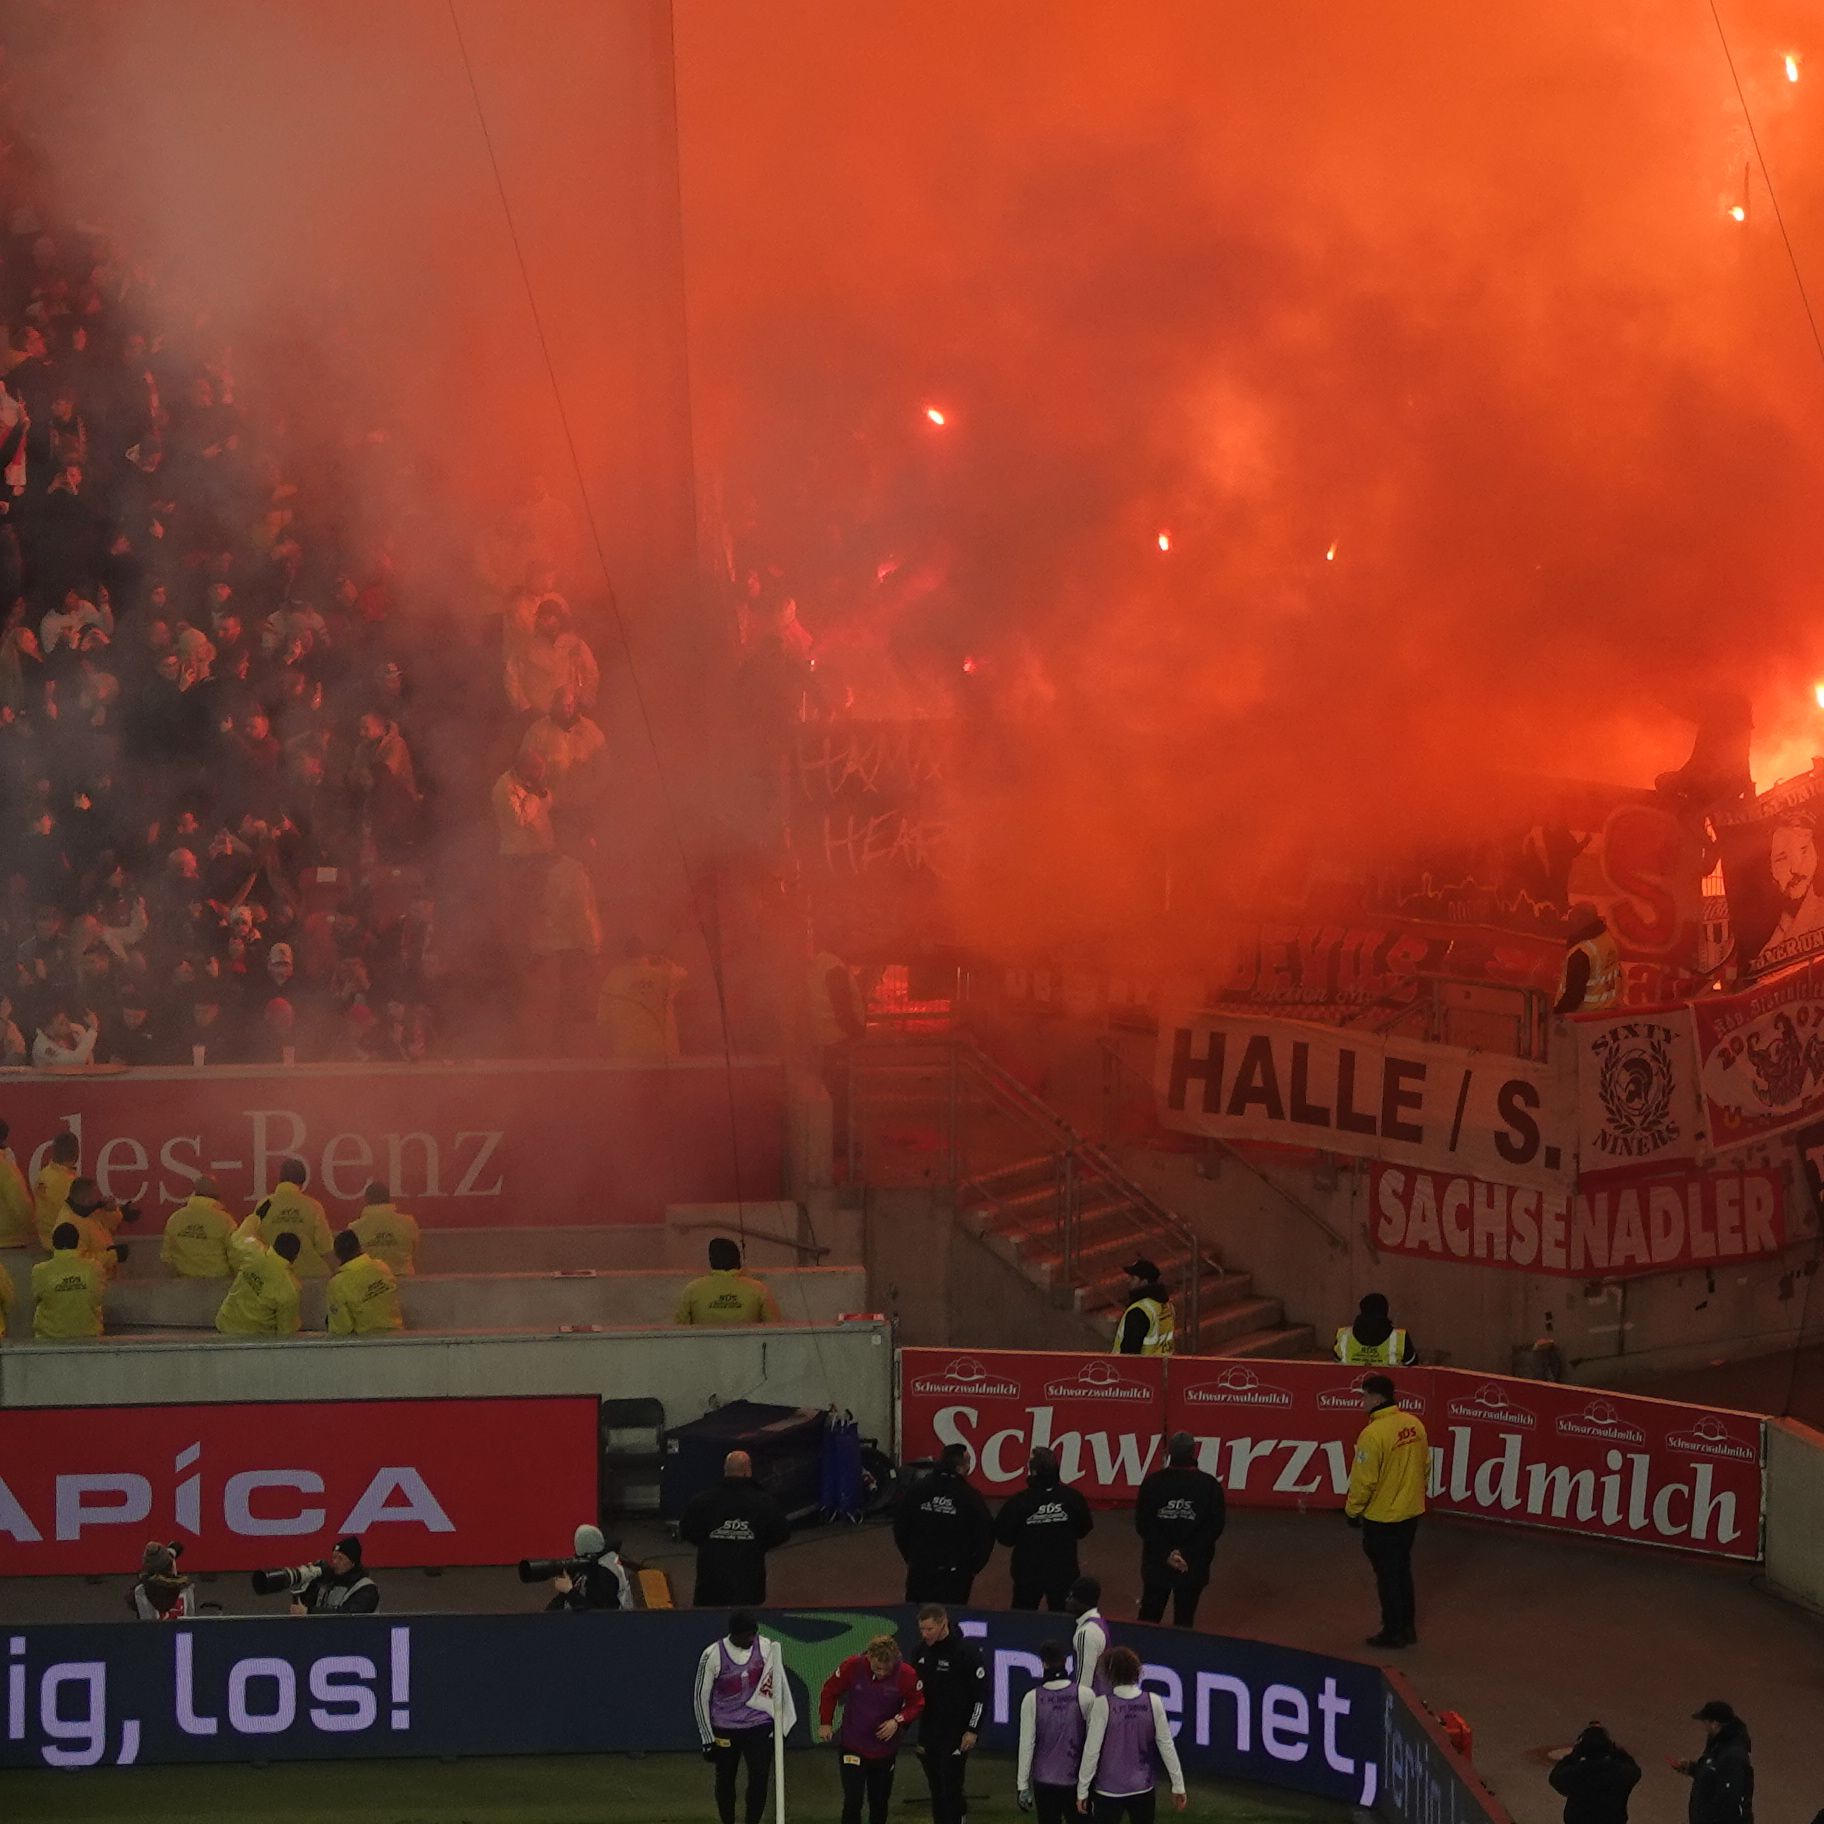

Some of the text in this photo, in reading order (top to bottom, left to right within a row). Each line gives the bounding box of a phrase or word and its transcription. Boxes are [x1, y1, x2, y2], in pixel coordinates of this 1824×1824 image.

[1592, 1023, 1681, 1057] SIXTY
[1167, 1028, 1562, 1170] HALLE / S.
[1376, 1167, 1780, 1271] SACHSENADLER
[914, 1380, 1018, 1397] Schwarzwaldmilch
[1047, 1385, 1152, 1401] Schwarzwaldmilch
[1186, 1390, 1290, 1406] Schwarzwaldmilch
[1449, 1402, 1535, 1427] Schwarzwaldmilch
[1558, 1419, 1643, 1444] Schwarzwaldmilch
[1667, 1435, 1754, 1461] Schwarzwaldmilch
[9, 1627, 411, 1767] ig, los!
